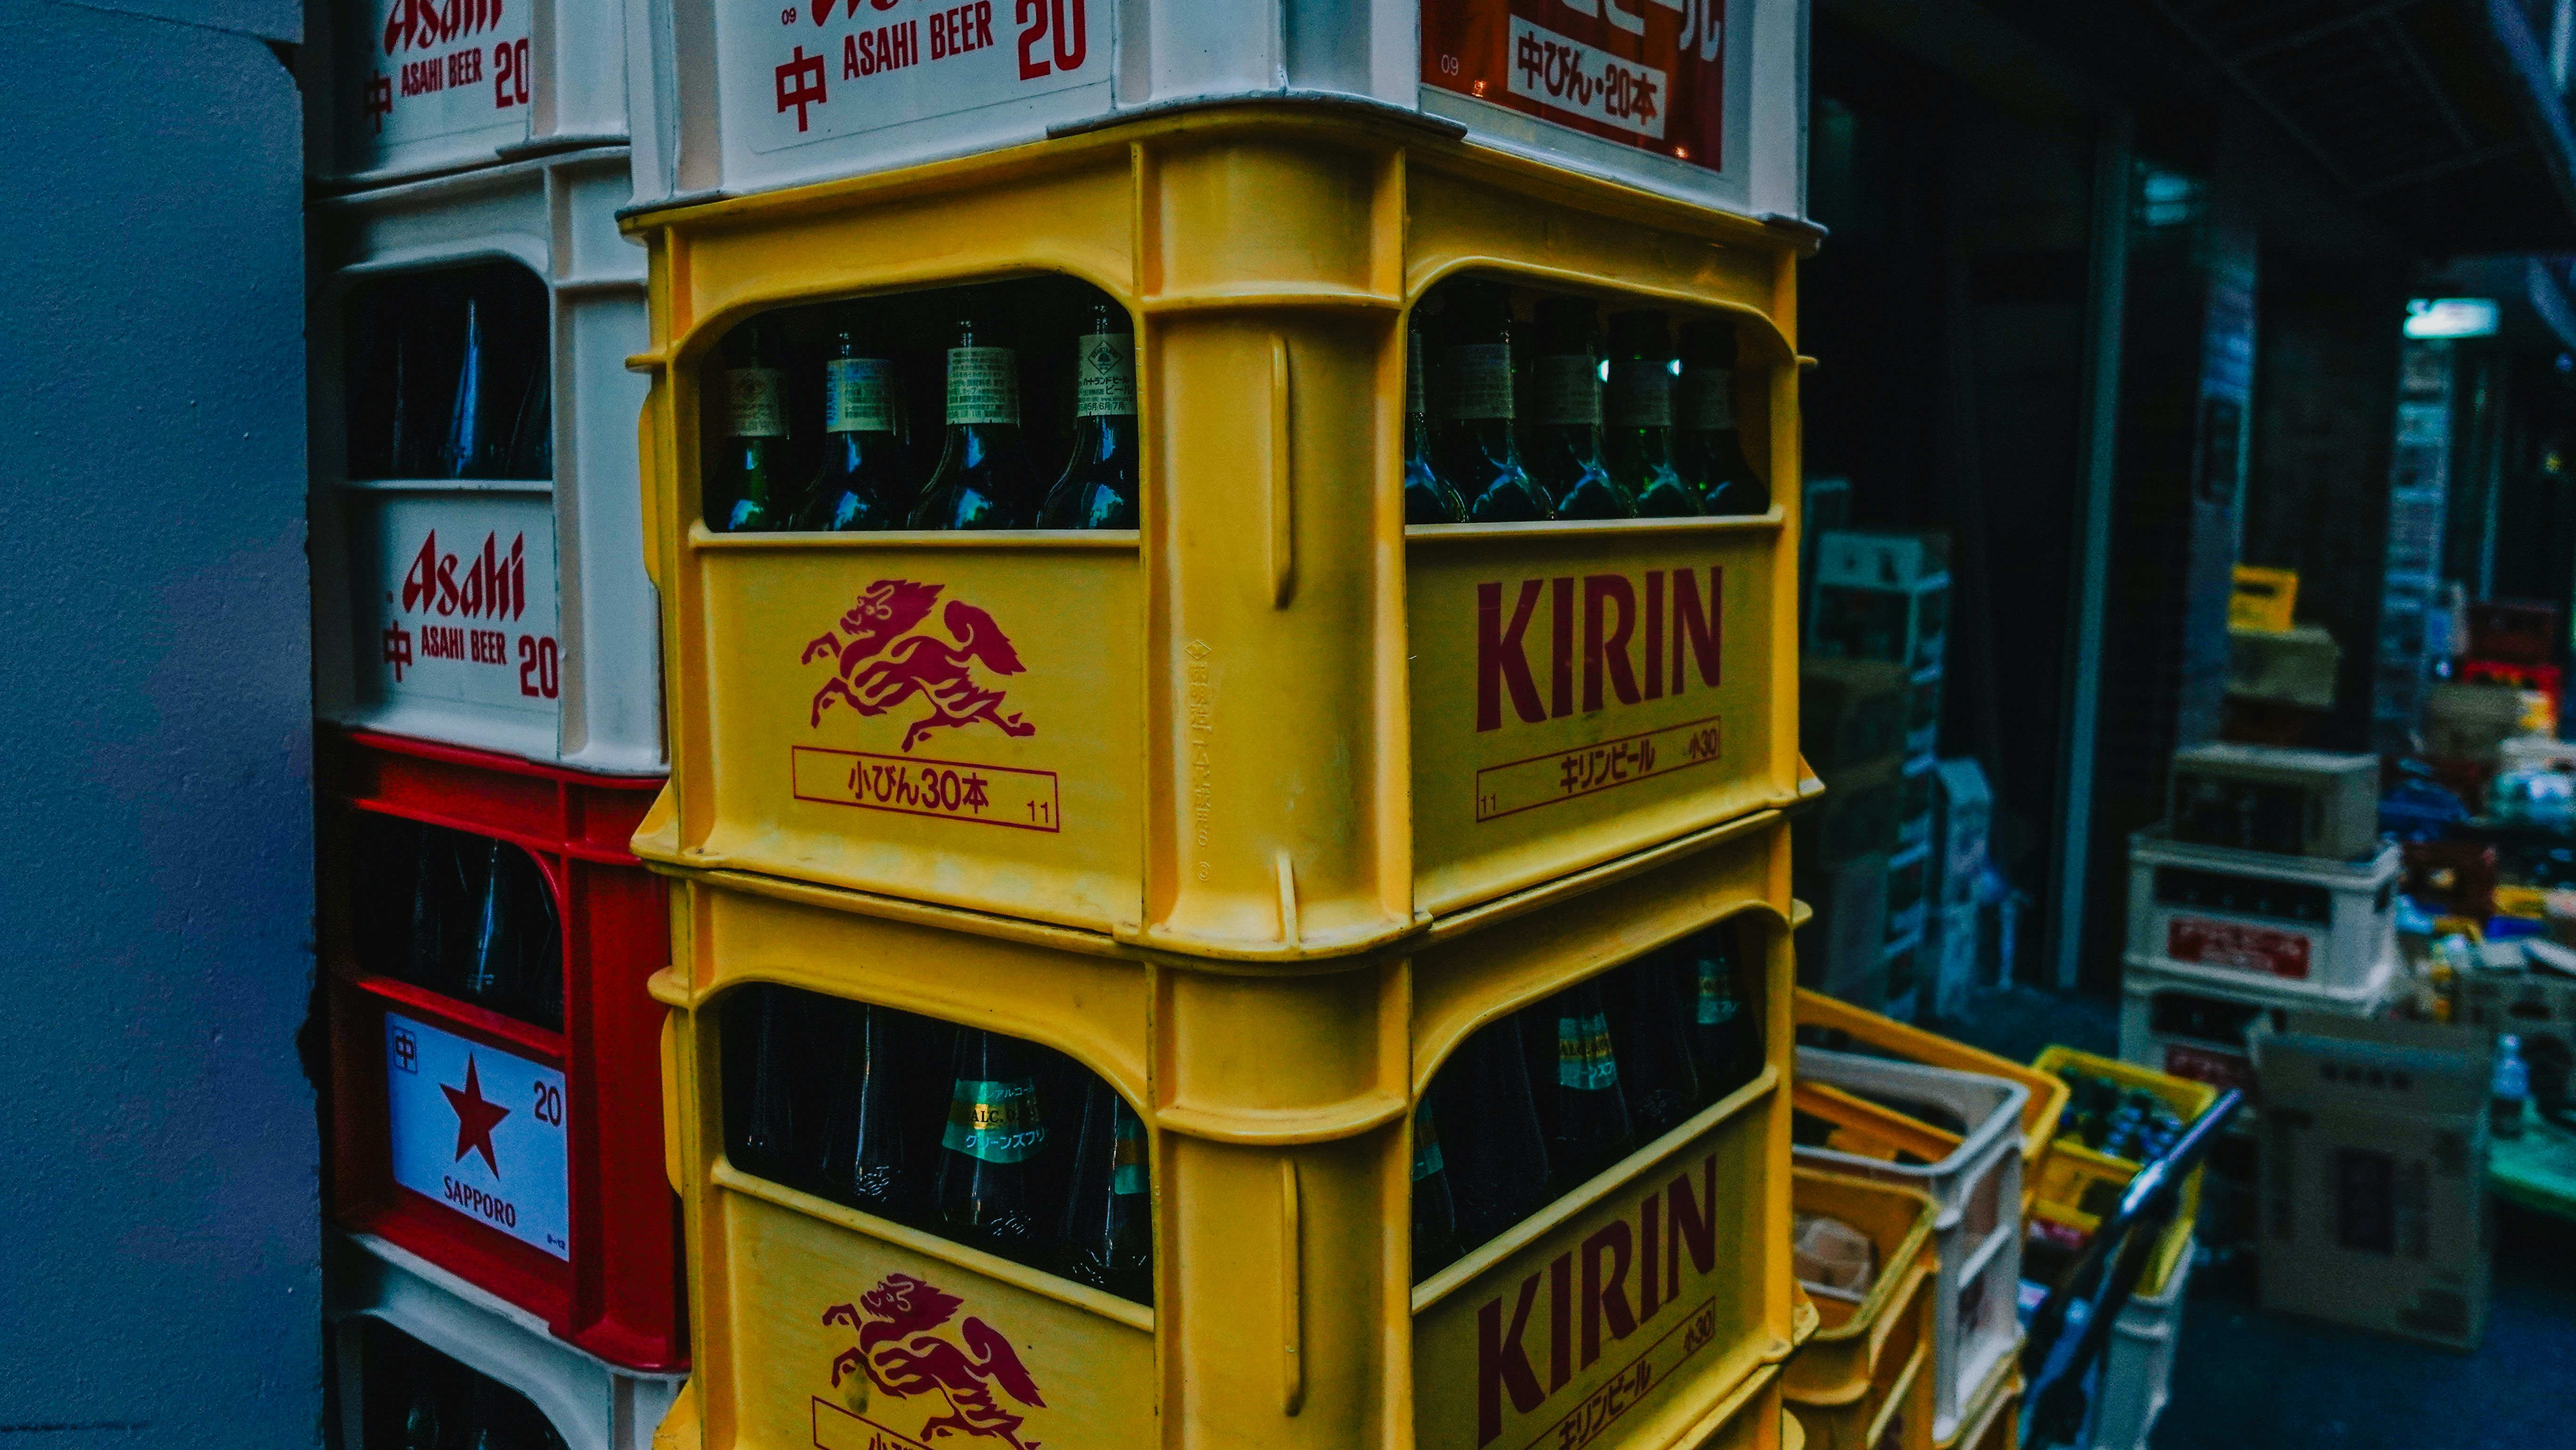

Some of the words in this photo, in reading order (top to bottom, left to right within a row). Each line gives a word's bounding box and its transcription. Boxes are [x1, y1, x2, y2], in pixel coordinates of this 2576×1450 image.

[781, 7, 797, 25] 09
[364, 69, 393, 133] 中
[401, 57, 443, 97] ASAHI
[448, 48, 482, 88] BEER
[494, 38, 529, 109] 20
[775, 46, 827, 132] 中
[844, 20, 918, 80] ASAHI
[930, 0, 993, 61] BEER
[1015, 0, 1087, 81] 20
[1441, 54, 1459, 76] 09
[1518, 32, 1657, 126] 中びん・20本
[402, 528, 526, 622] Asahi
[382, 620, 412, 682] 中
[422, 625, 465, 660] ASAHI
[470, 628, 507, 666] BEER
[518, 635, 559, 699] 20
[1476, 566, 1723, 733] KIRIN
[848, 761, 989, 814] 小びん30本
[1027, 800, 1049, 823] 11
[1481, 793, 1497, 814] 11
[1560, 739, 1656, 794] キリンビール
[395, 1032, 415, 1071] 中
[533, 1081, 562, 1127] 20
[443, 1175, 516, 1228] SAPPORO
[1477, 1152, 1717, 1450] KIRIN
[1558, 1359, 1650, 1450] キリンビール
